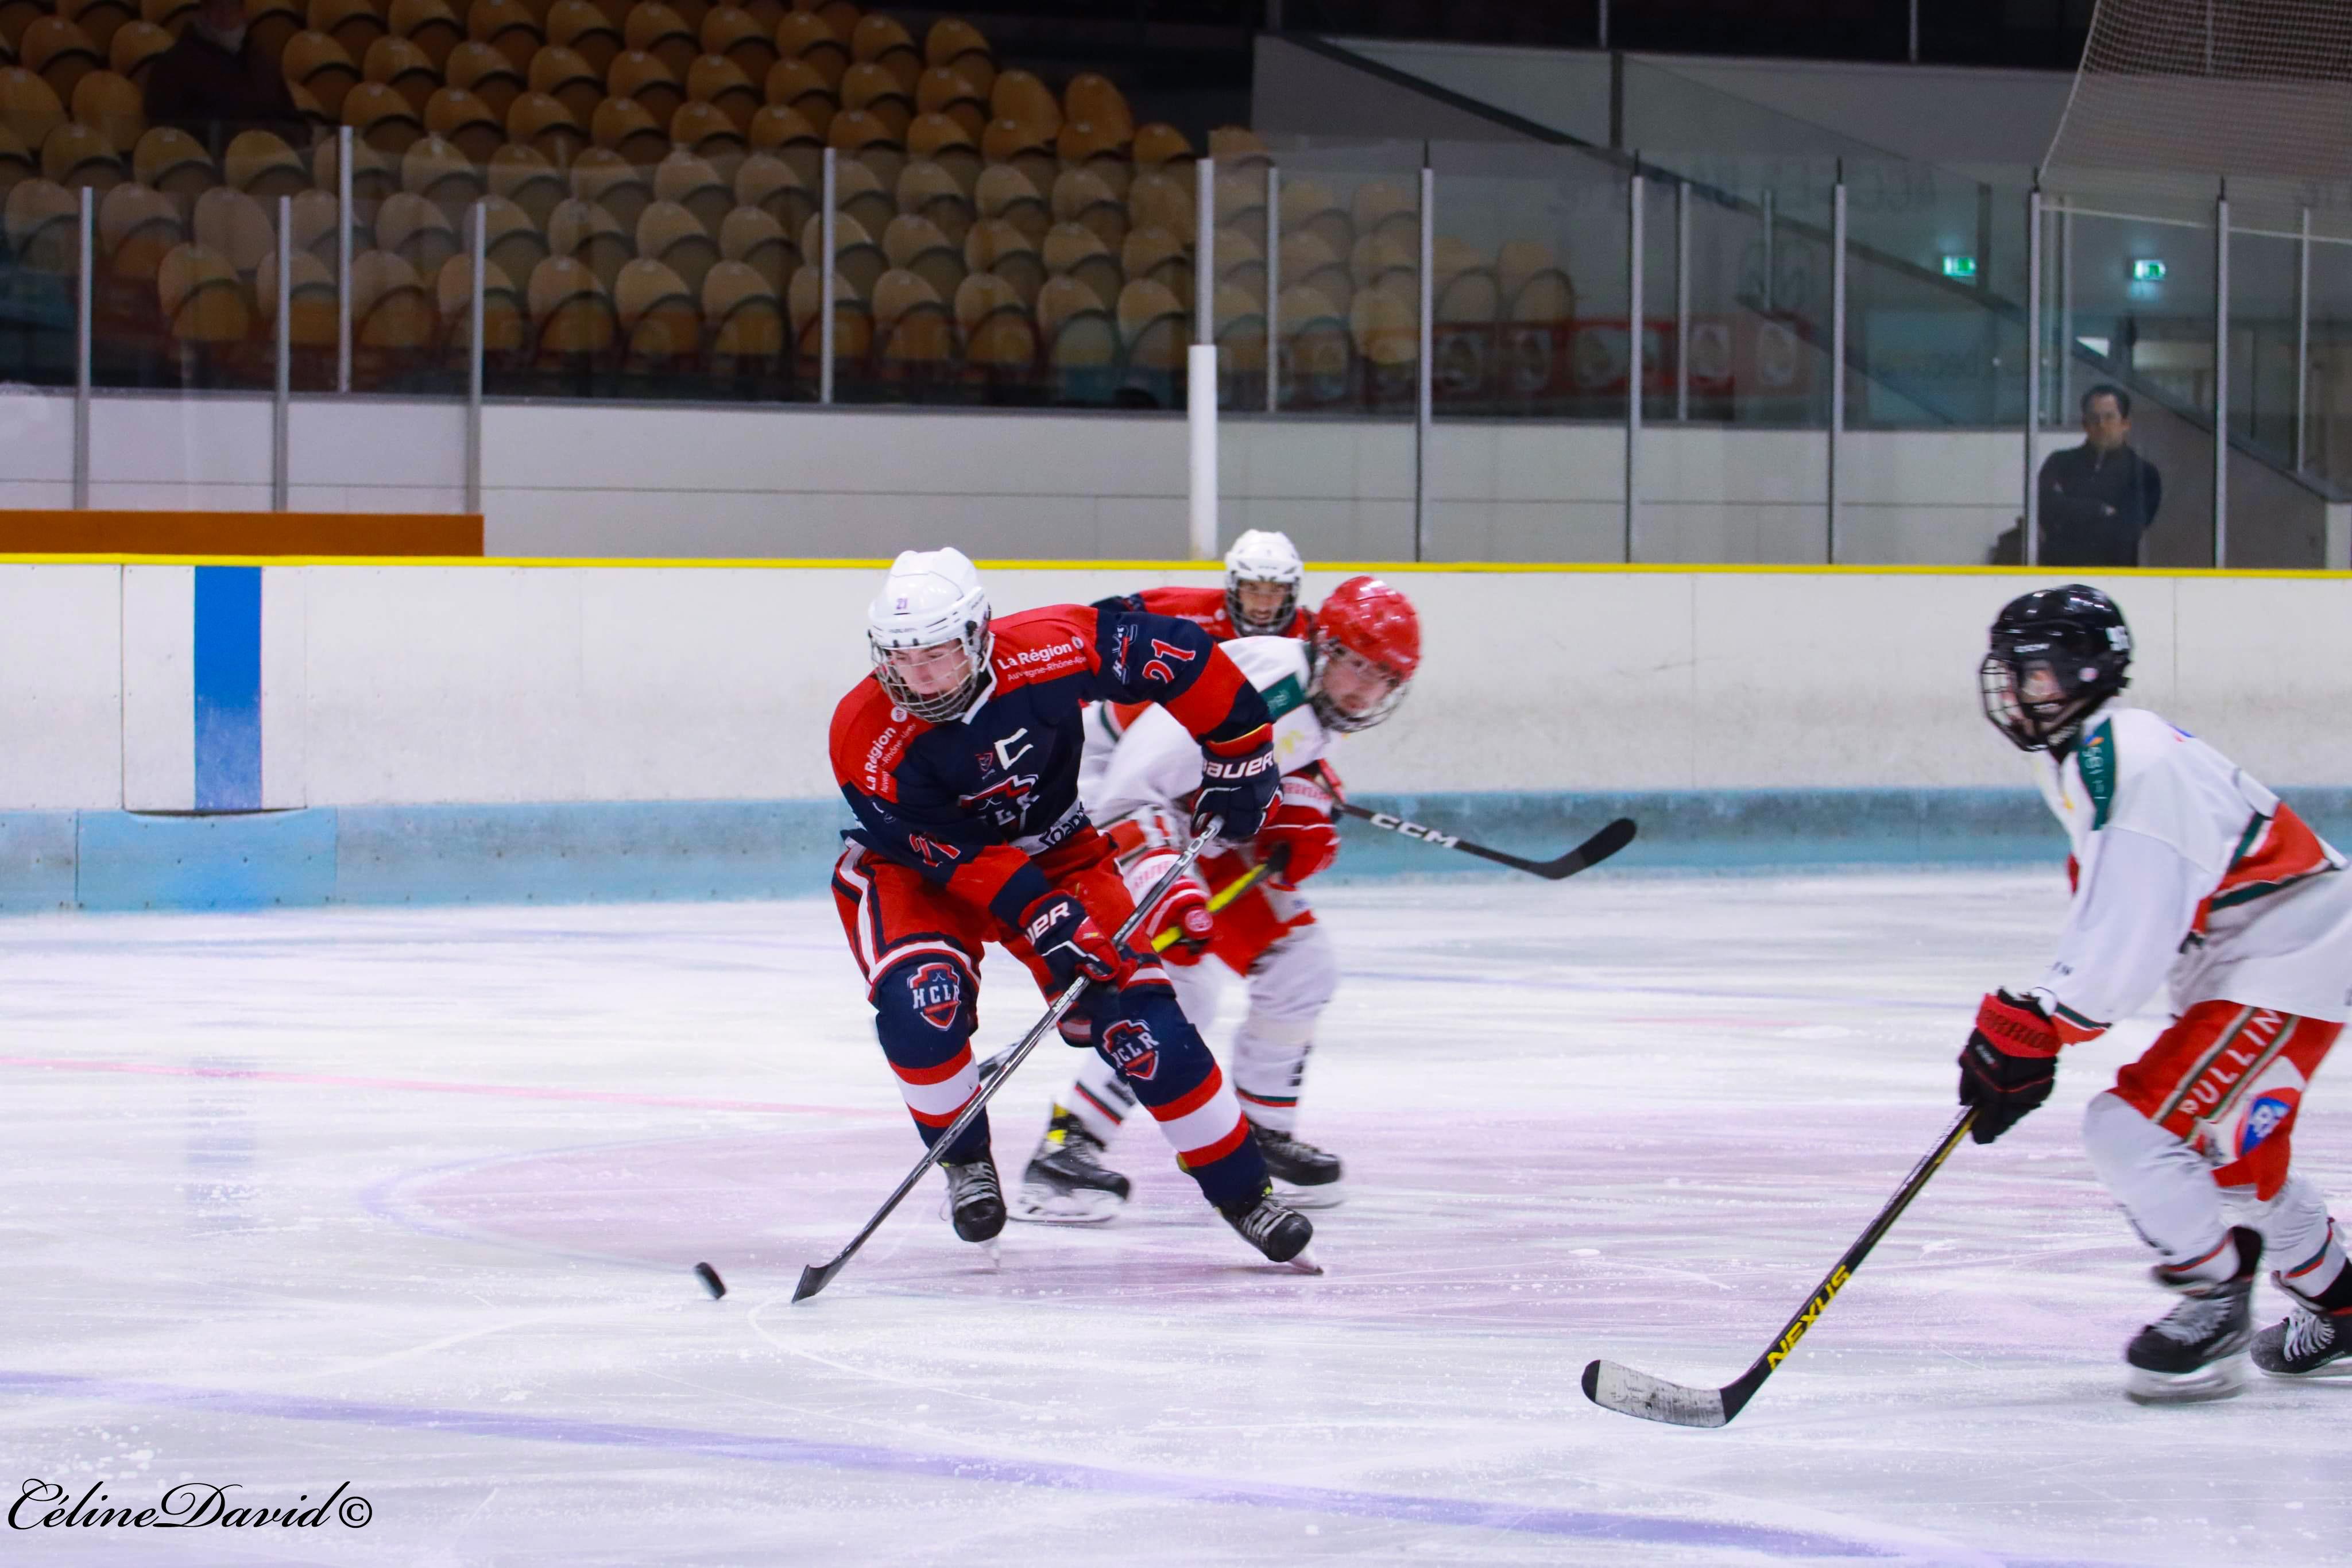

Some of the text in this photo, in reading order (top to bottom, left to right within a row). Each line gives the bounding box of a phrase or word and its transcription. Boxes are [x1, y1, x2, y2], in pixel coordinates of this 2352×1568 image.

[996, 642, 1073, 670] La Région
[864, 726, 897, 791] La Région
[993, 727, 1034, 771] C
[1370, 812, 1459, 848] CCM
[1024, 901, 1071, 947] UER
[912, 984, 960, 1010] HCLR
[1111, 1031, 1160, 1068] HCLR
[2177, 1008, 2284, 1115] PULLIN
[1766, 1264, 1851, 1370] NEXUS
